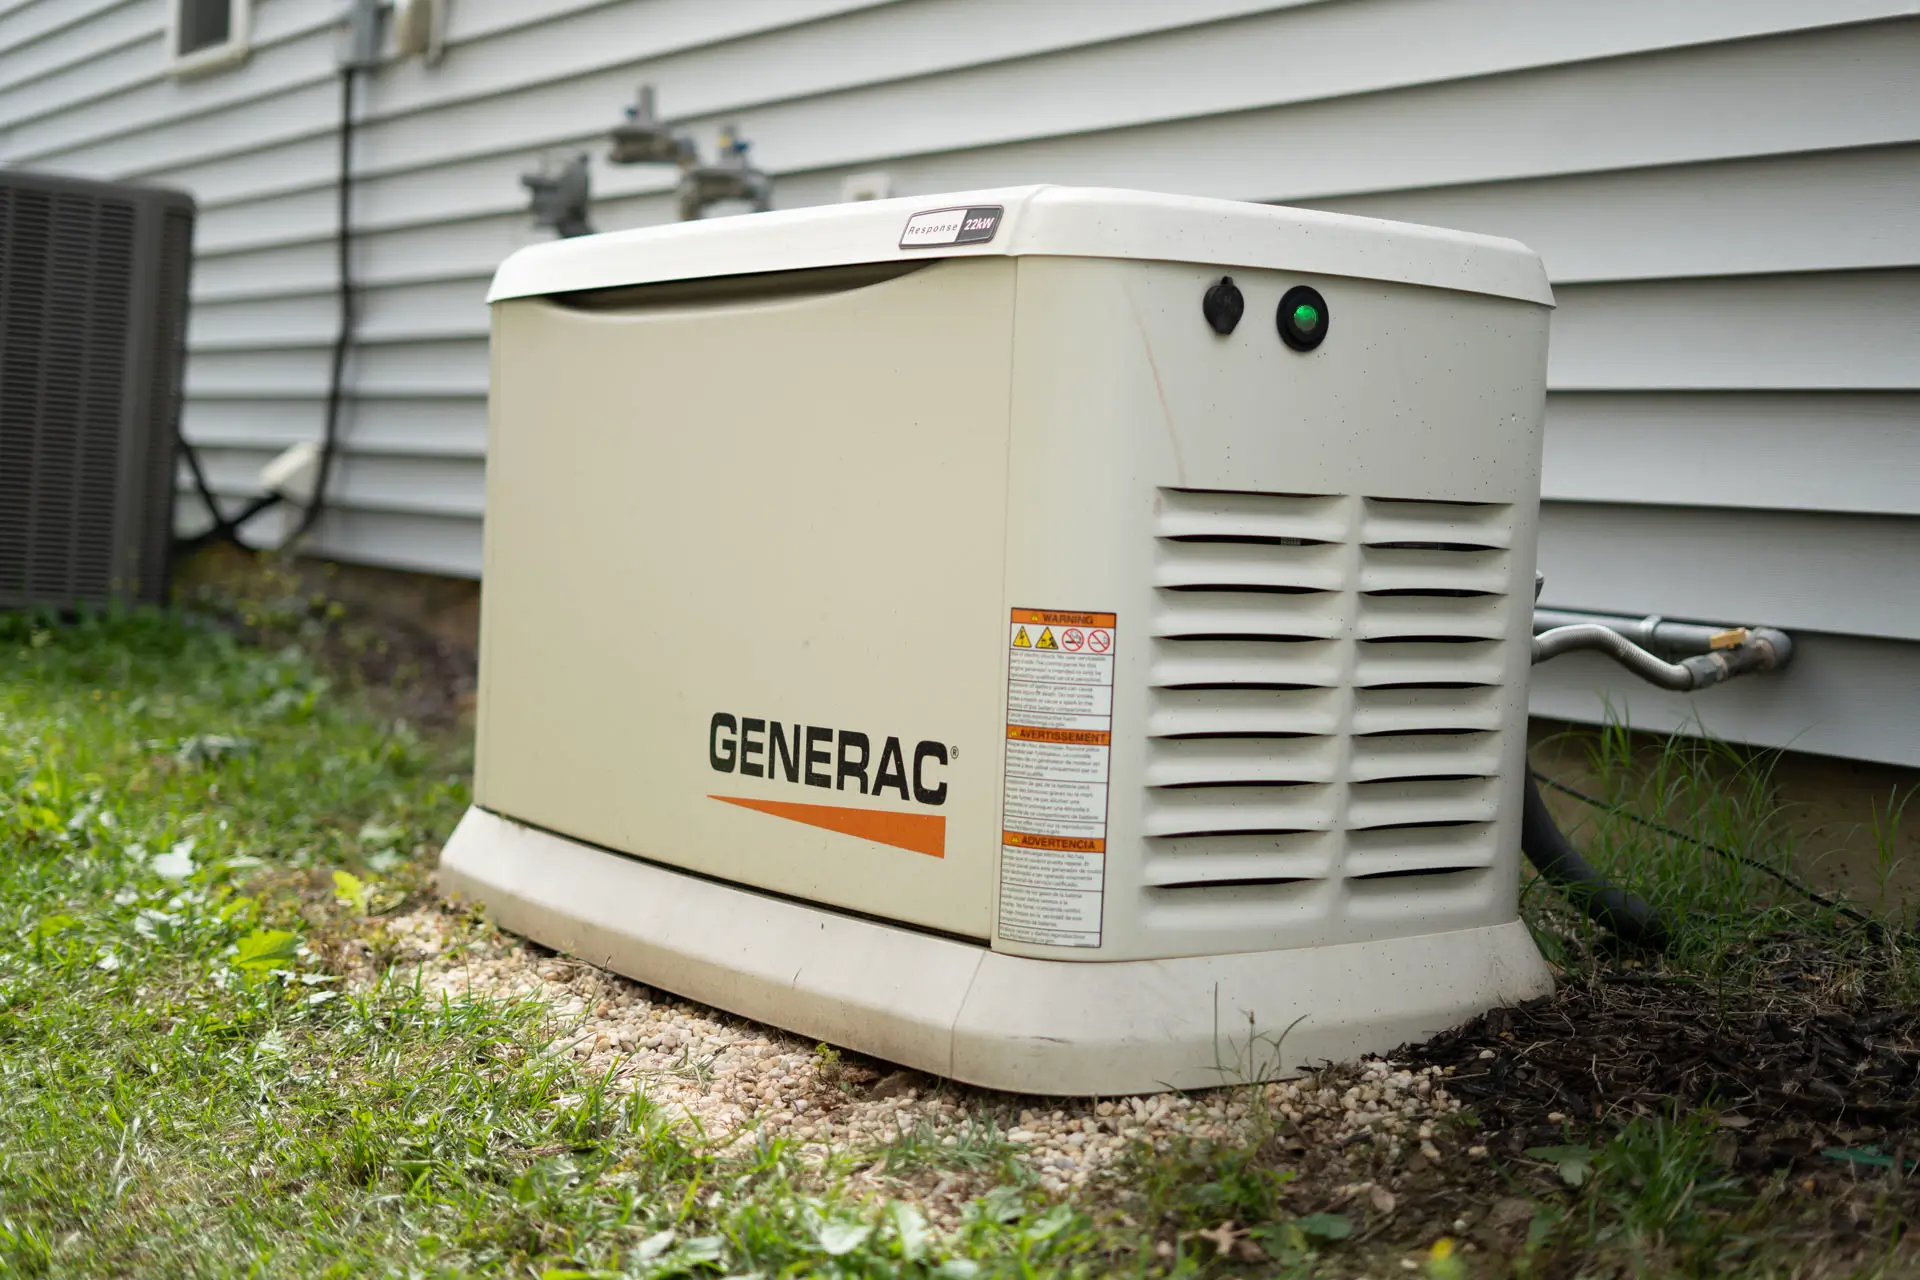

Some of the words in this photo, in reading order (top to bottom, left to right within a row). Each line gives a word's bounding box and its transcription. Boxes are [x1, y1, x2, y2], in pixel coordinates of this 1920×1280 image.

[908, 224, 958, 235] Response
[964, 218, 995, 230] 22kW
[1042, 613, 1094, 624] WARNING
[1019, 729, 1105, 742] AVERTISSEMENT
[1022, 836, 1096, 848] ADVERTENCIA
